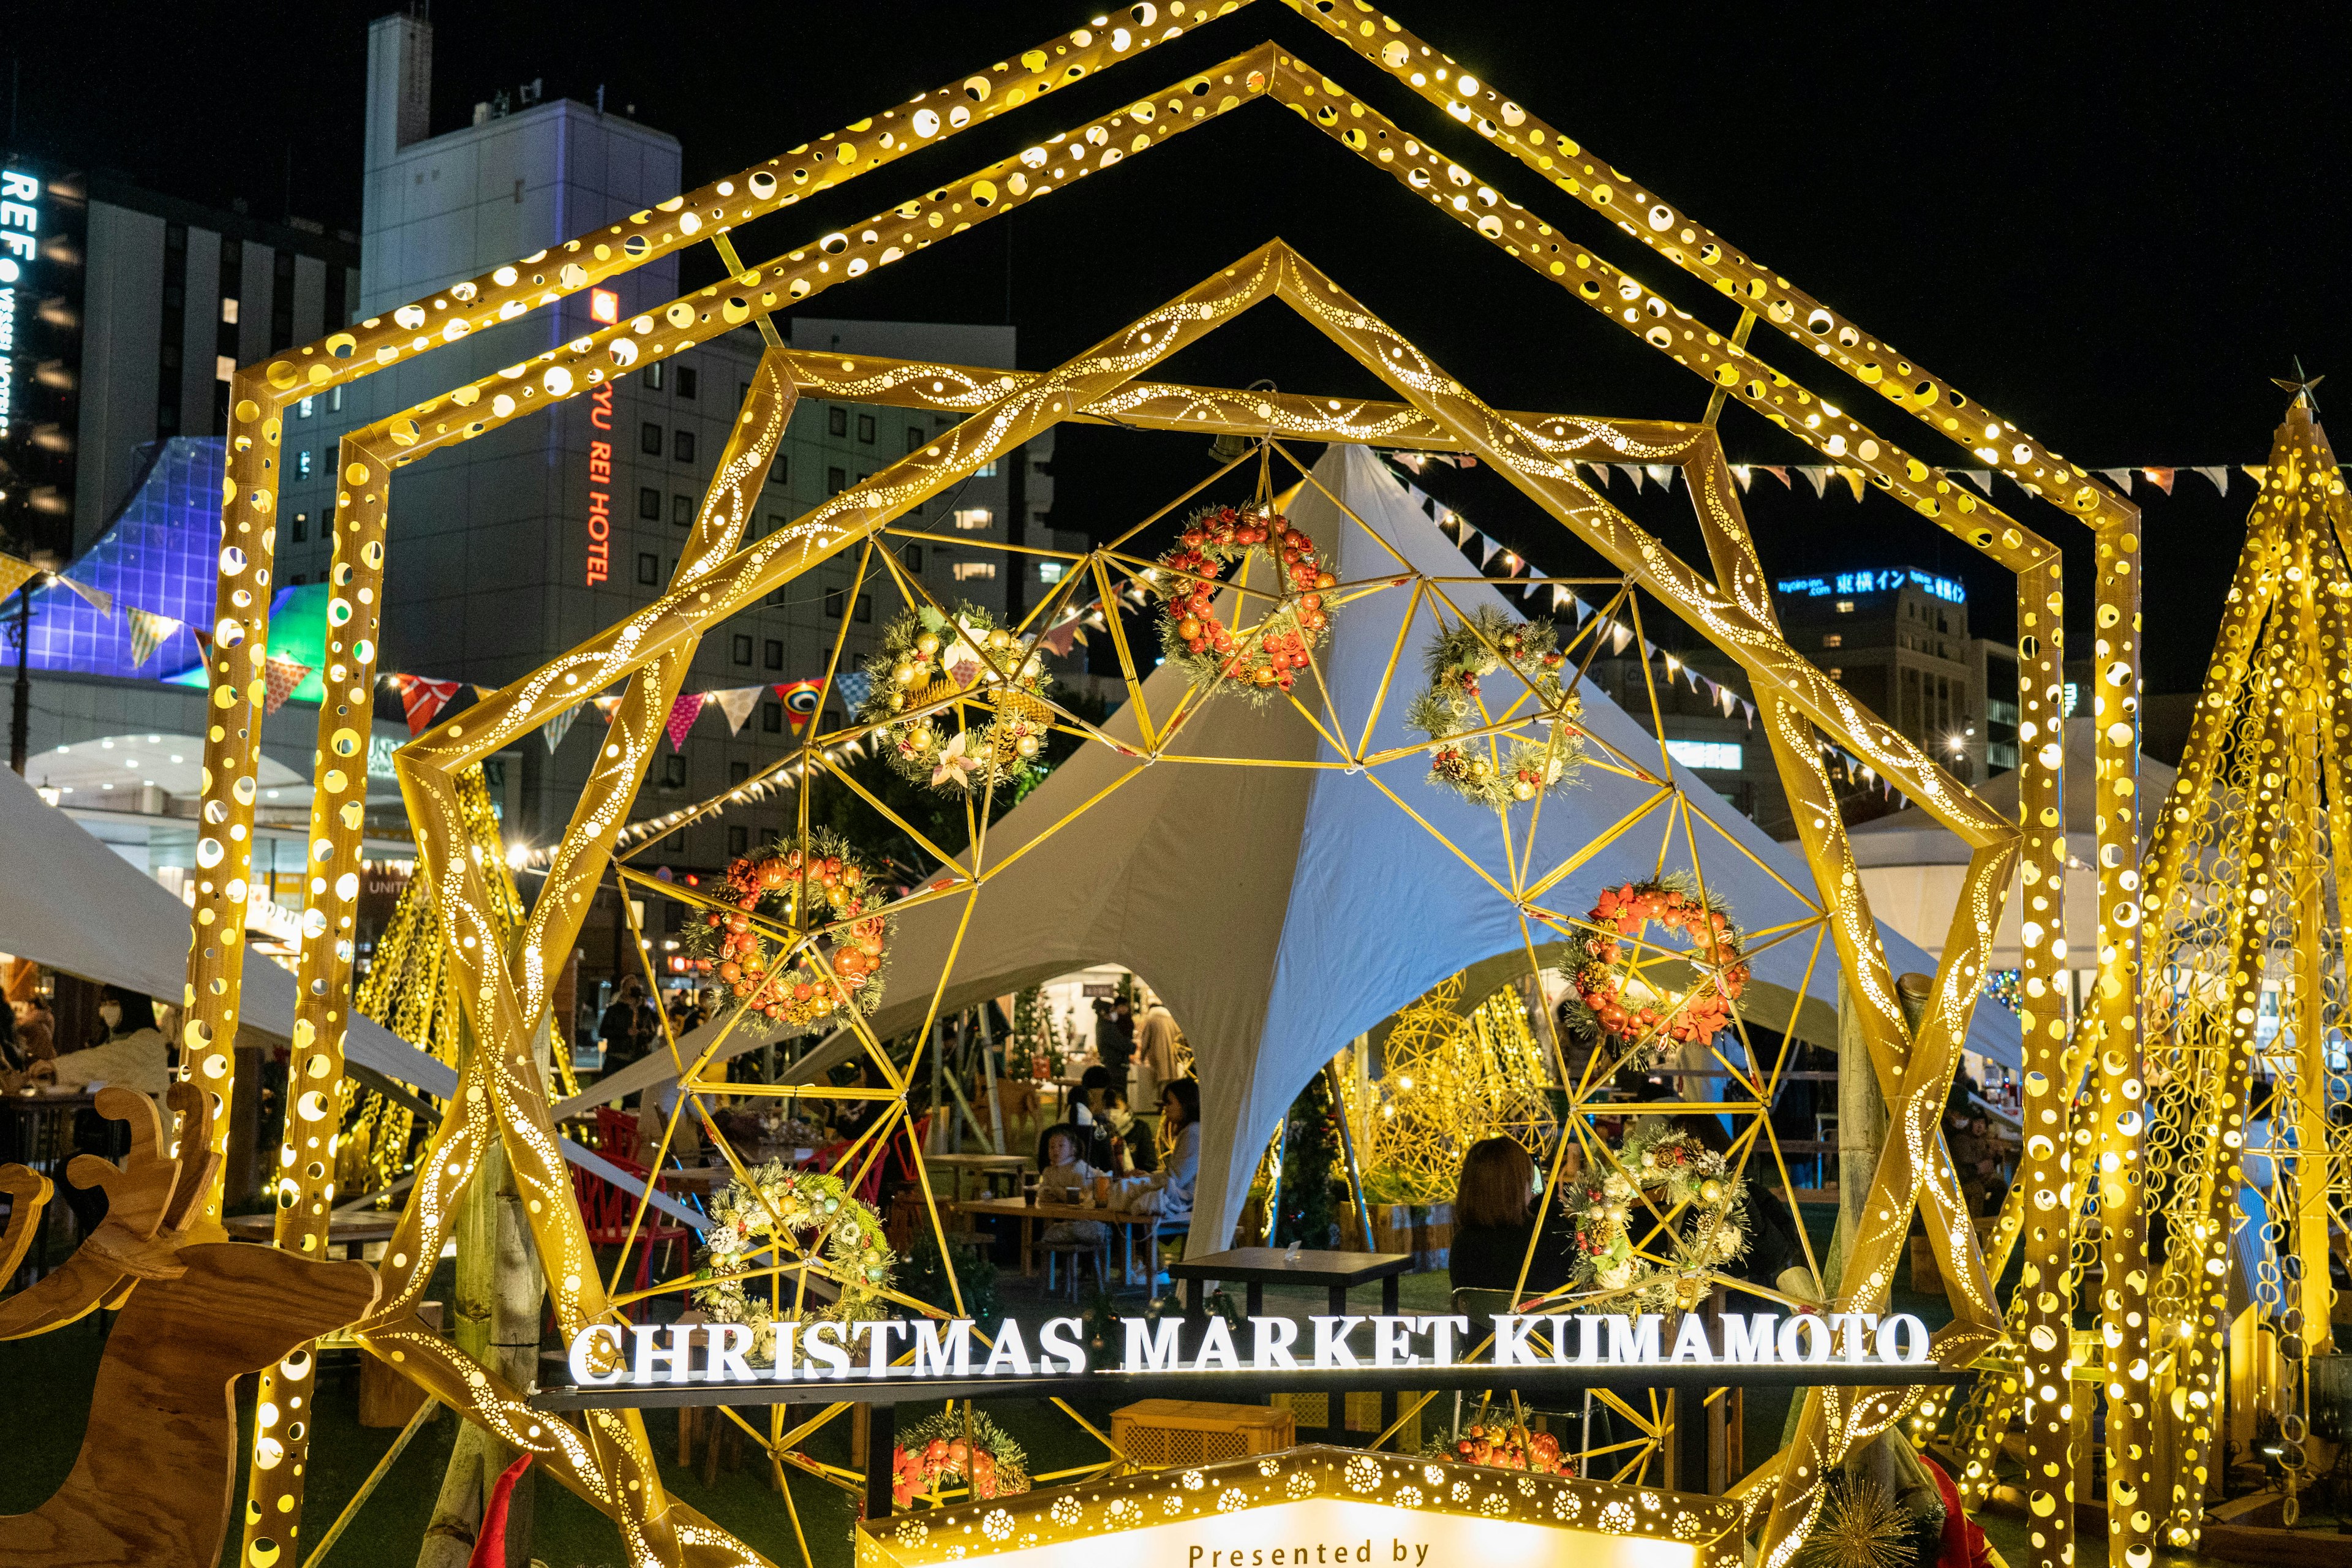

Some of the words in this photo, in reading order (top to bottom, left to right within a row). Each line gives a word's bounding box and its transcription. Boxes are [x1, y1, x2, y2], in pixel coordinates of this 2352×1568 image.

[1, 170, 38, 261] REF
[590, 440, 611, 484] REI
[586, 491, 610, 587] HOTEL
[569, 1317, 1087, 1386] CHRISTMAS
[1120, 1314, 1468, 1372] MARKET
[1490, 1311, 1931, 1367] KUMAMOTO
[1188, 1539, 1371, 1568] Presented
[1392, 1538, 1429, 1567] by
